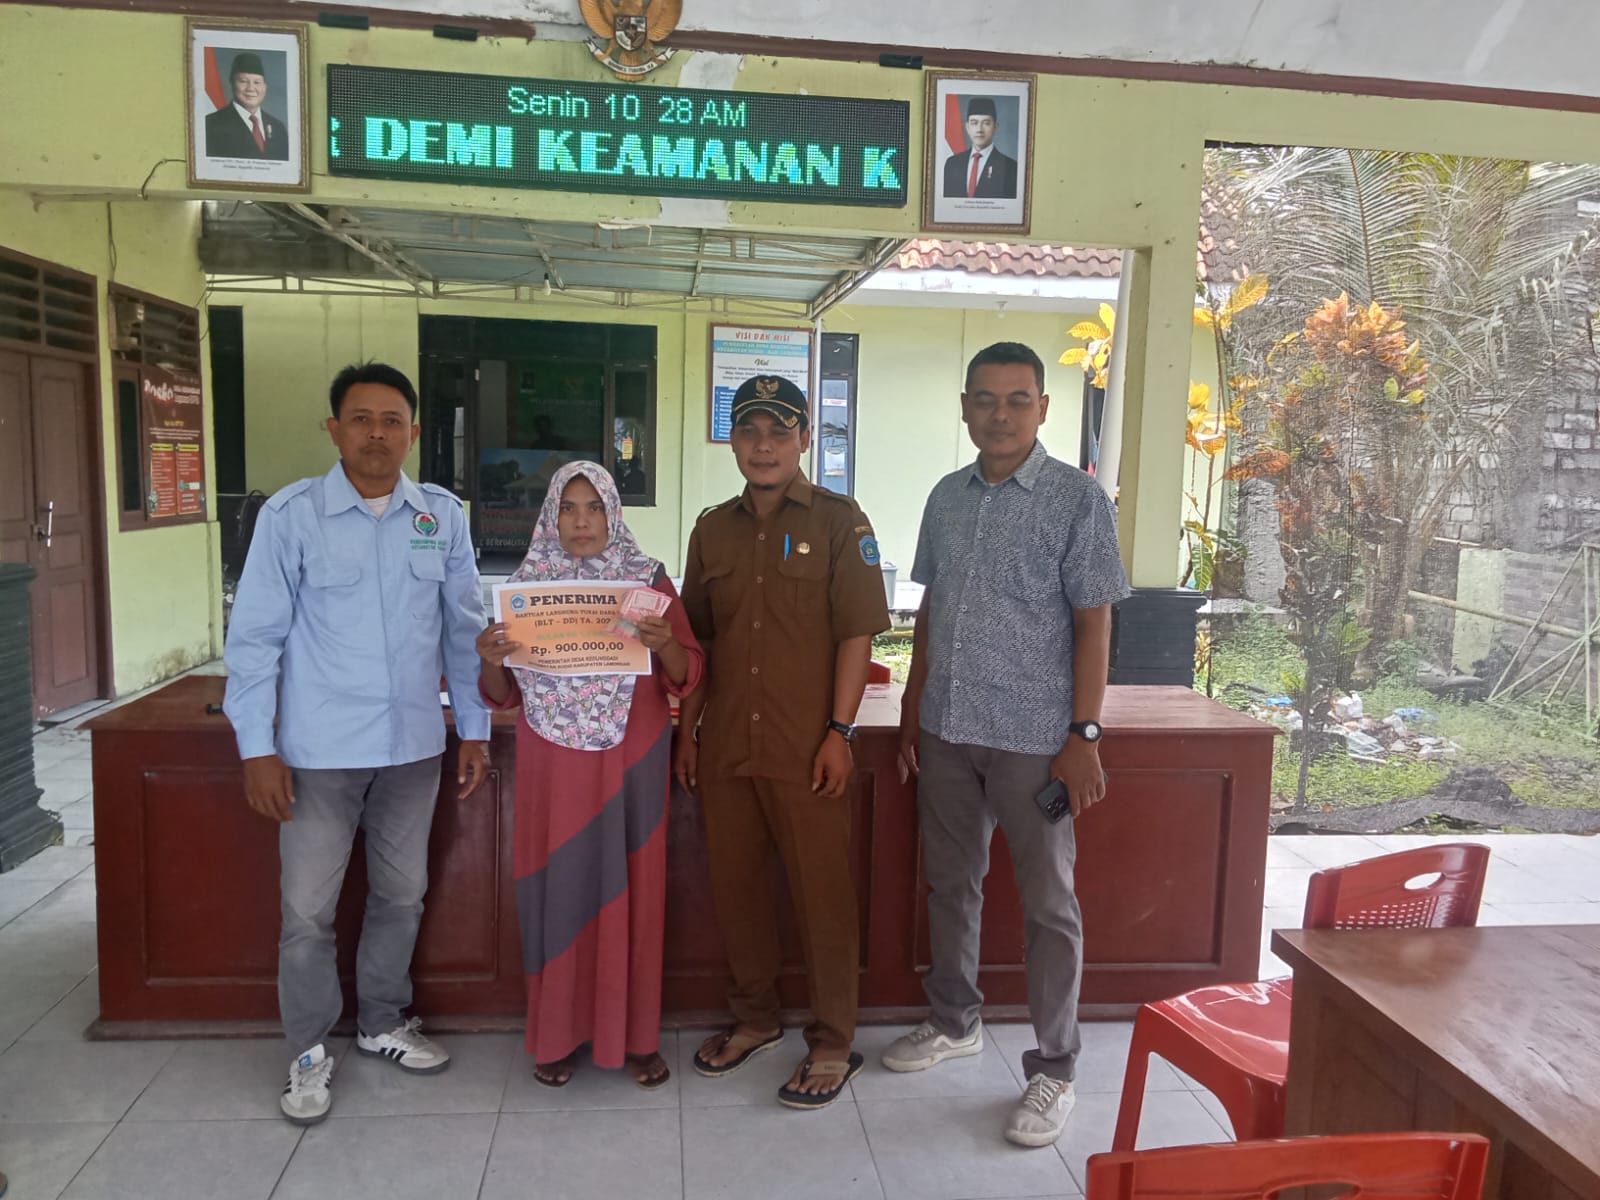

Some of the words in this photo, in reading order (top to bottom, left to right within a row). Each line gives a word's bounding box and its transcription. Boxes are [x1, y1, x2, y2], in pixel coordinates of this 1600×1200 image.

[508, 86, 590, 118] Senin
[605, 93, 640, 120] 10
[659, 95, 692, 124] 28
[700, 99, 745, 127] AM
[365, 116, 514, 169] DEMI
[538, 129, 840, 186] KEAMANAN
[863, 146, 901, 189] K
[736, 332, 751, 340] VISI
[529, 594, 617, 607] PENERIMA
[534, 620, 553, 628] (BLT
[530, 646, 551, 656] Rp.
[555, 641, 625, 652] 900.000,00
